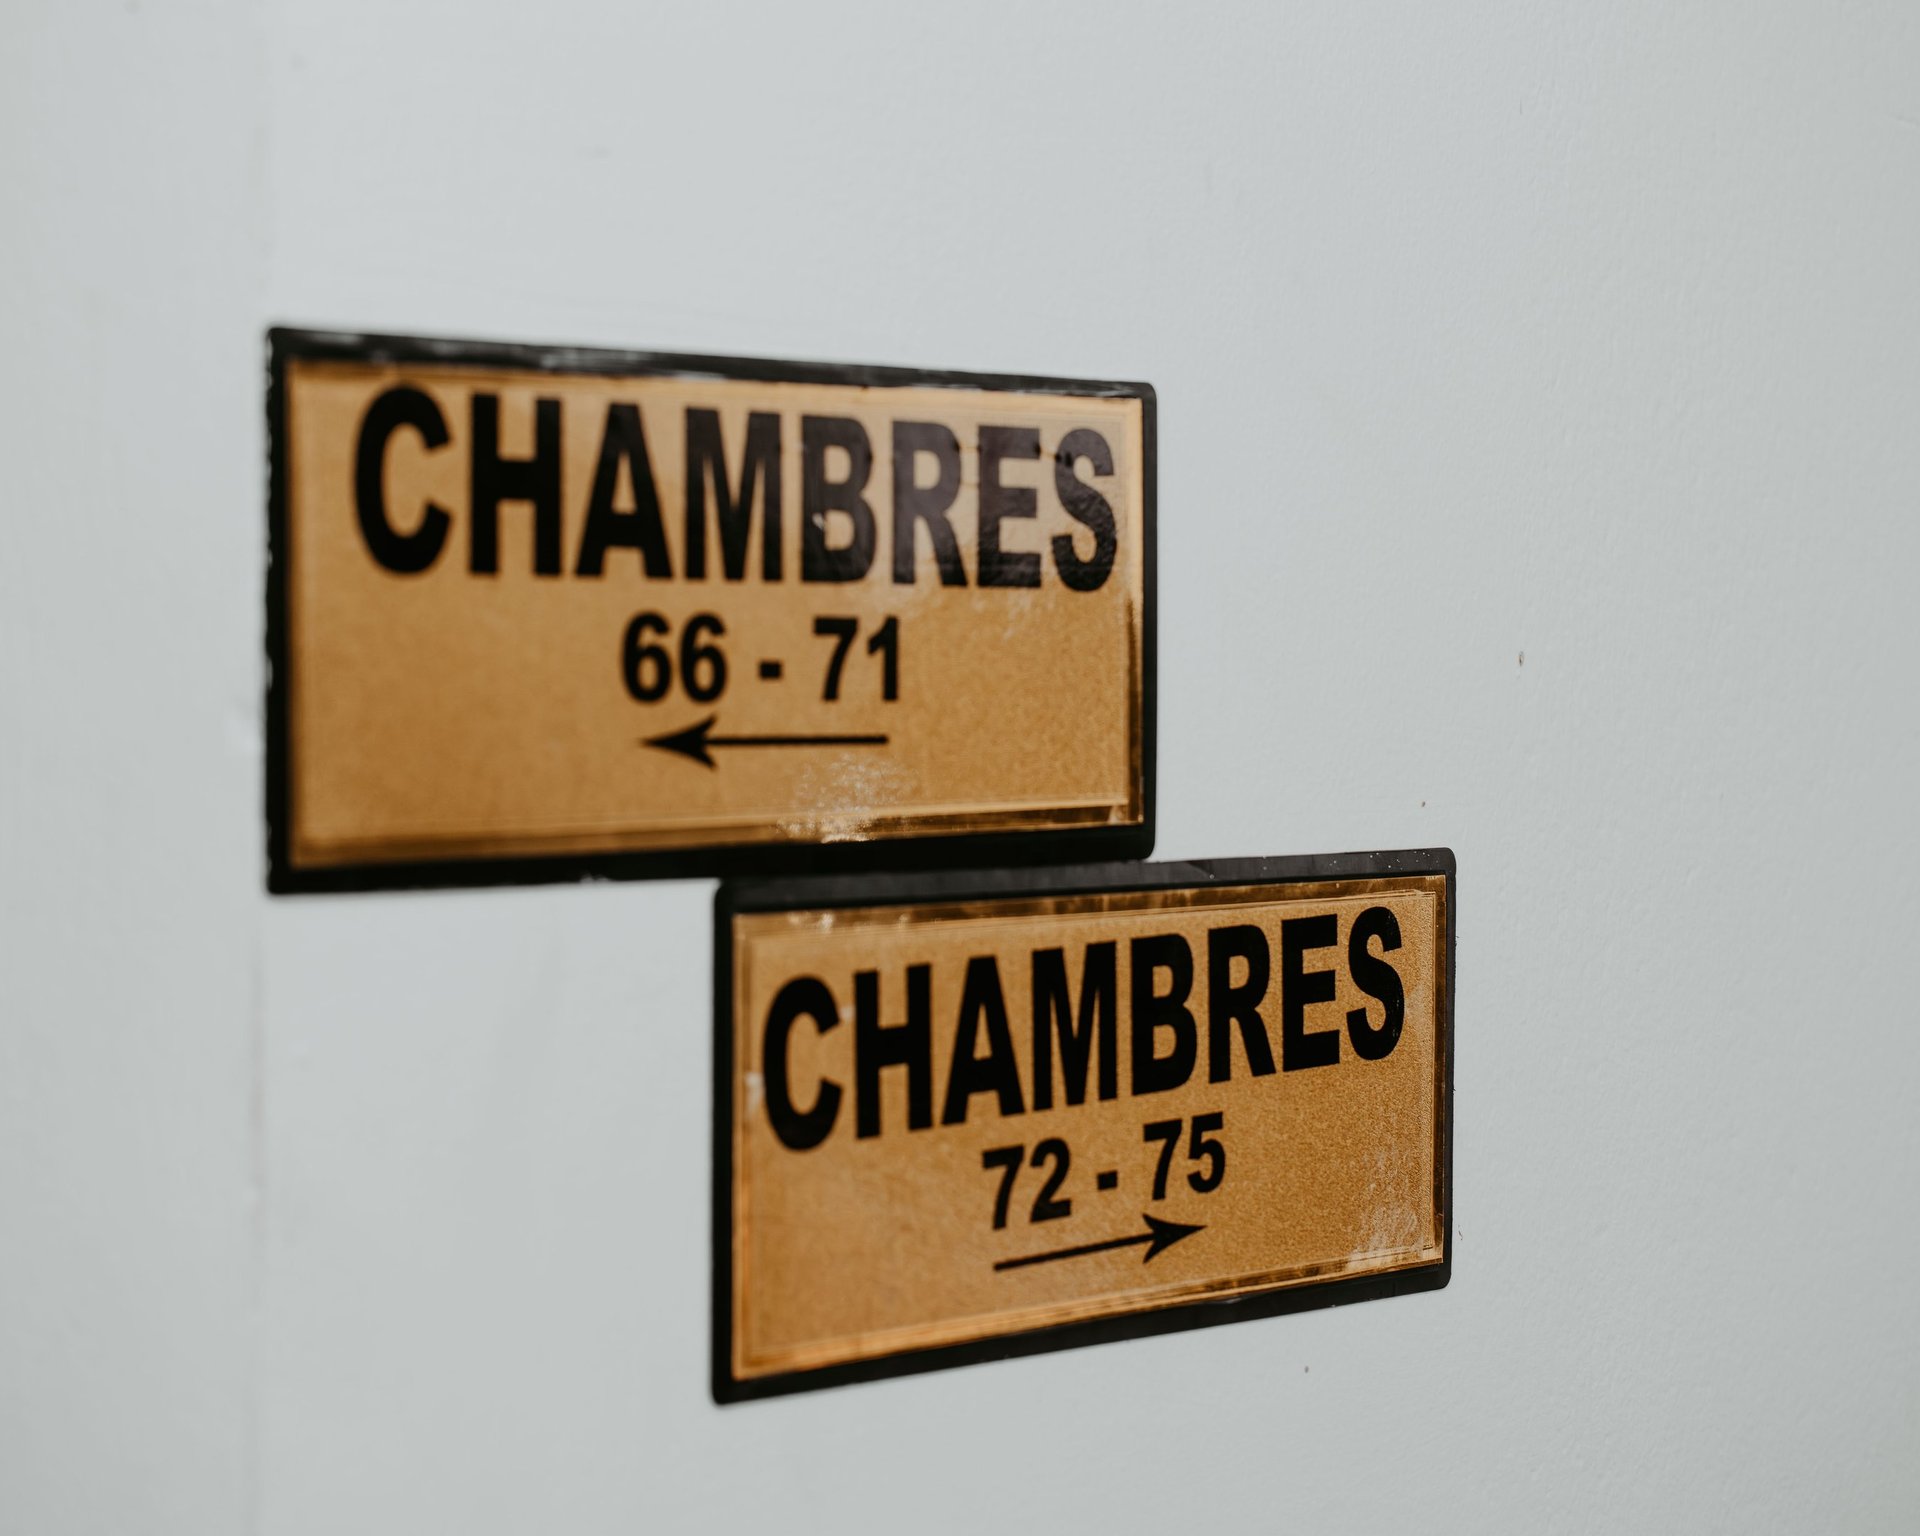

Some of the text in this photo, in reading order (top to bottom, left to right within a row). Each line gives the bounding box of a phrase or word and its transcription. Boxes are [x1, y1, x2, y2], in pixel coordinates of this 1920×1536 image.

[352, 378, 1118, 593] CHAMBRES
[621, 612, 728, 705] 66
[812, 615, 900, 703] 71
[761, 905, 1406, 1153] CHAMBRES
[981, 1138, 1073, 1231] 72
[1143, 1111, 1227, 1201] 75
